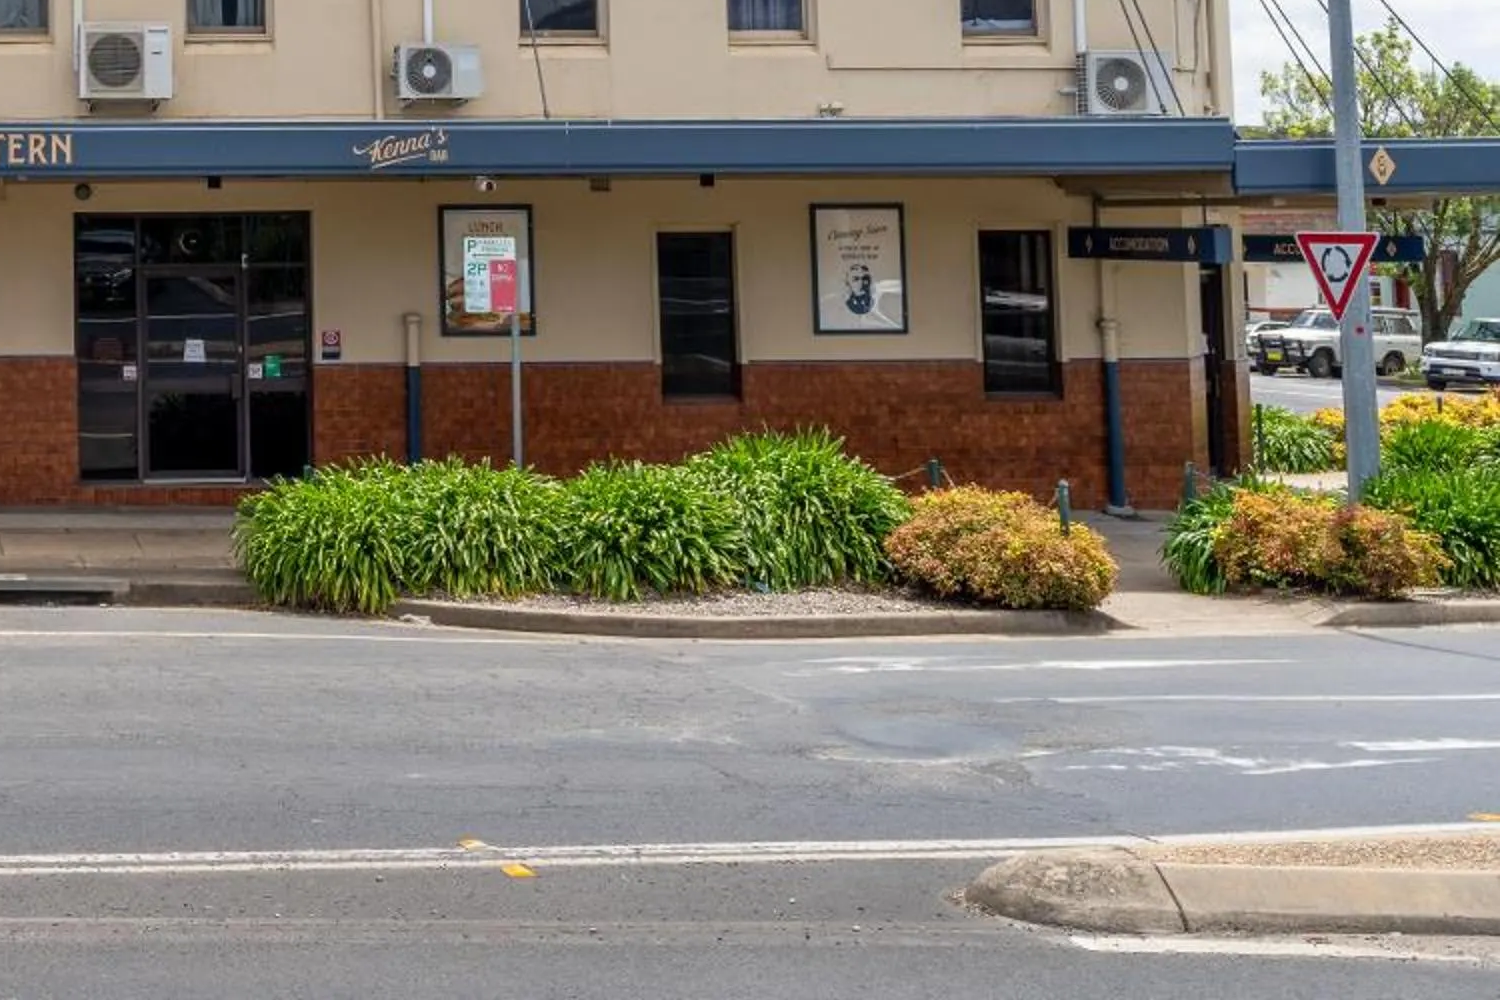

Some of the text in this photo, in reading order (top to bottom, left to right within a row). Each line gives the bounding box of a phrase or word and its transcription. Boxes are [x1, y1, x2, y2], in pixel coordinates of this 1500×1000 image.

[353, 126, 446, 164] Kenna's
[467, 239, 477, 253] P
[467, 263, 487, 276] 2P
